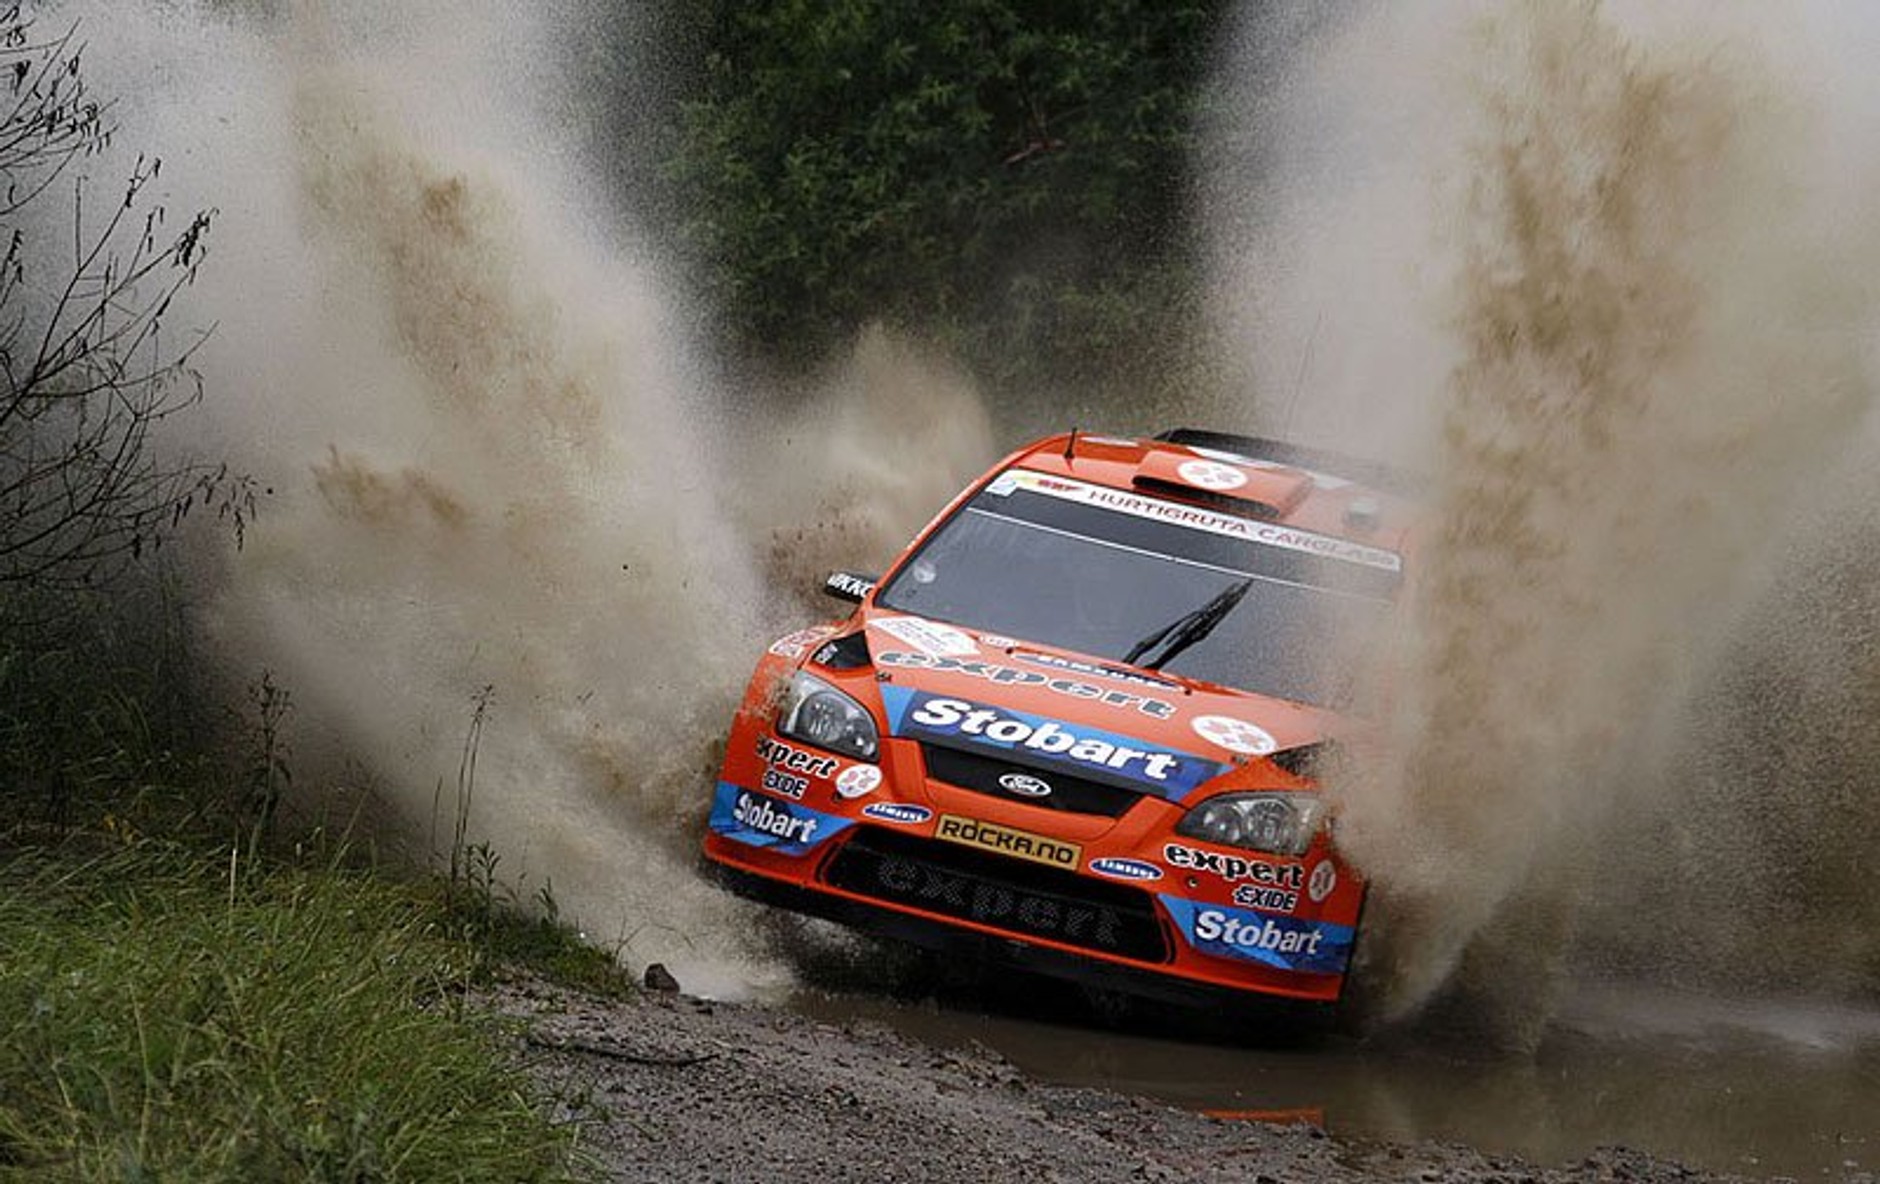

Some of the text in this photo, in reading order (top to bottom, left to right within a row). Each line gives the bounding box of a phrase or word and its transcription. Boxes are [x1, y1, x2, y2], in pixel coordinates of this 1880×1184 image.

[1088, 489, 1248, 534] HURTIGRUTA
[877, 652, 1178, 720] expert
[911, 698, 1178, 780] Stobart
[733, 792, 817, 842] Stobart
[1164, 844, 1305, 888] expert
[1234, 885, 1298, 912] EXIDE
[1196, 911, 1323, 955] Stobart
